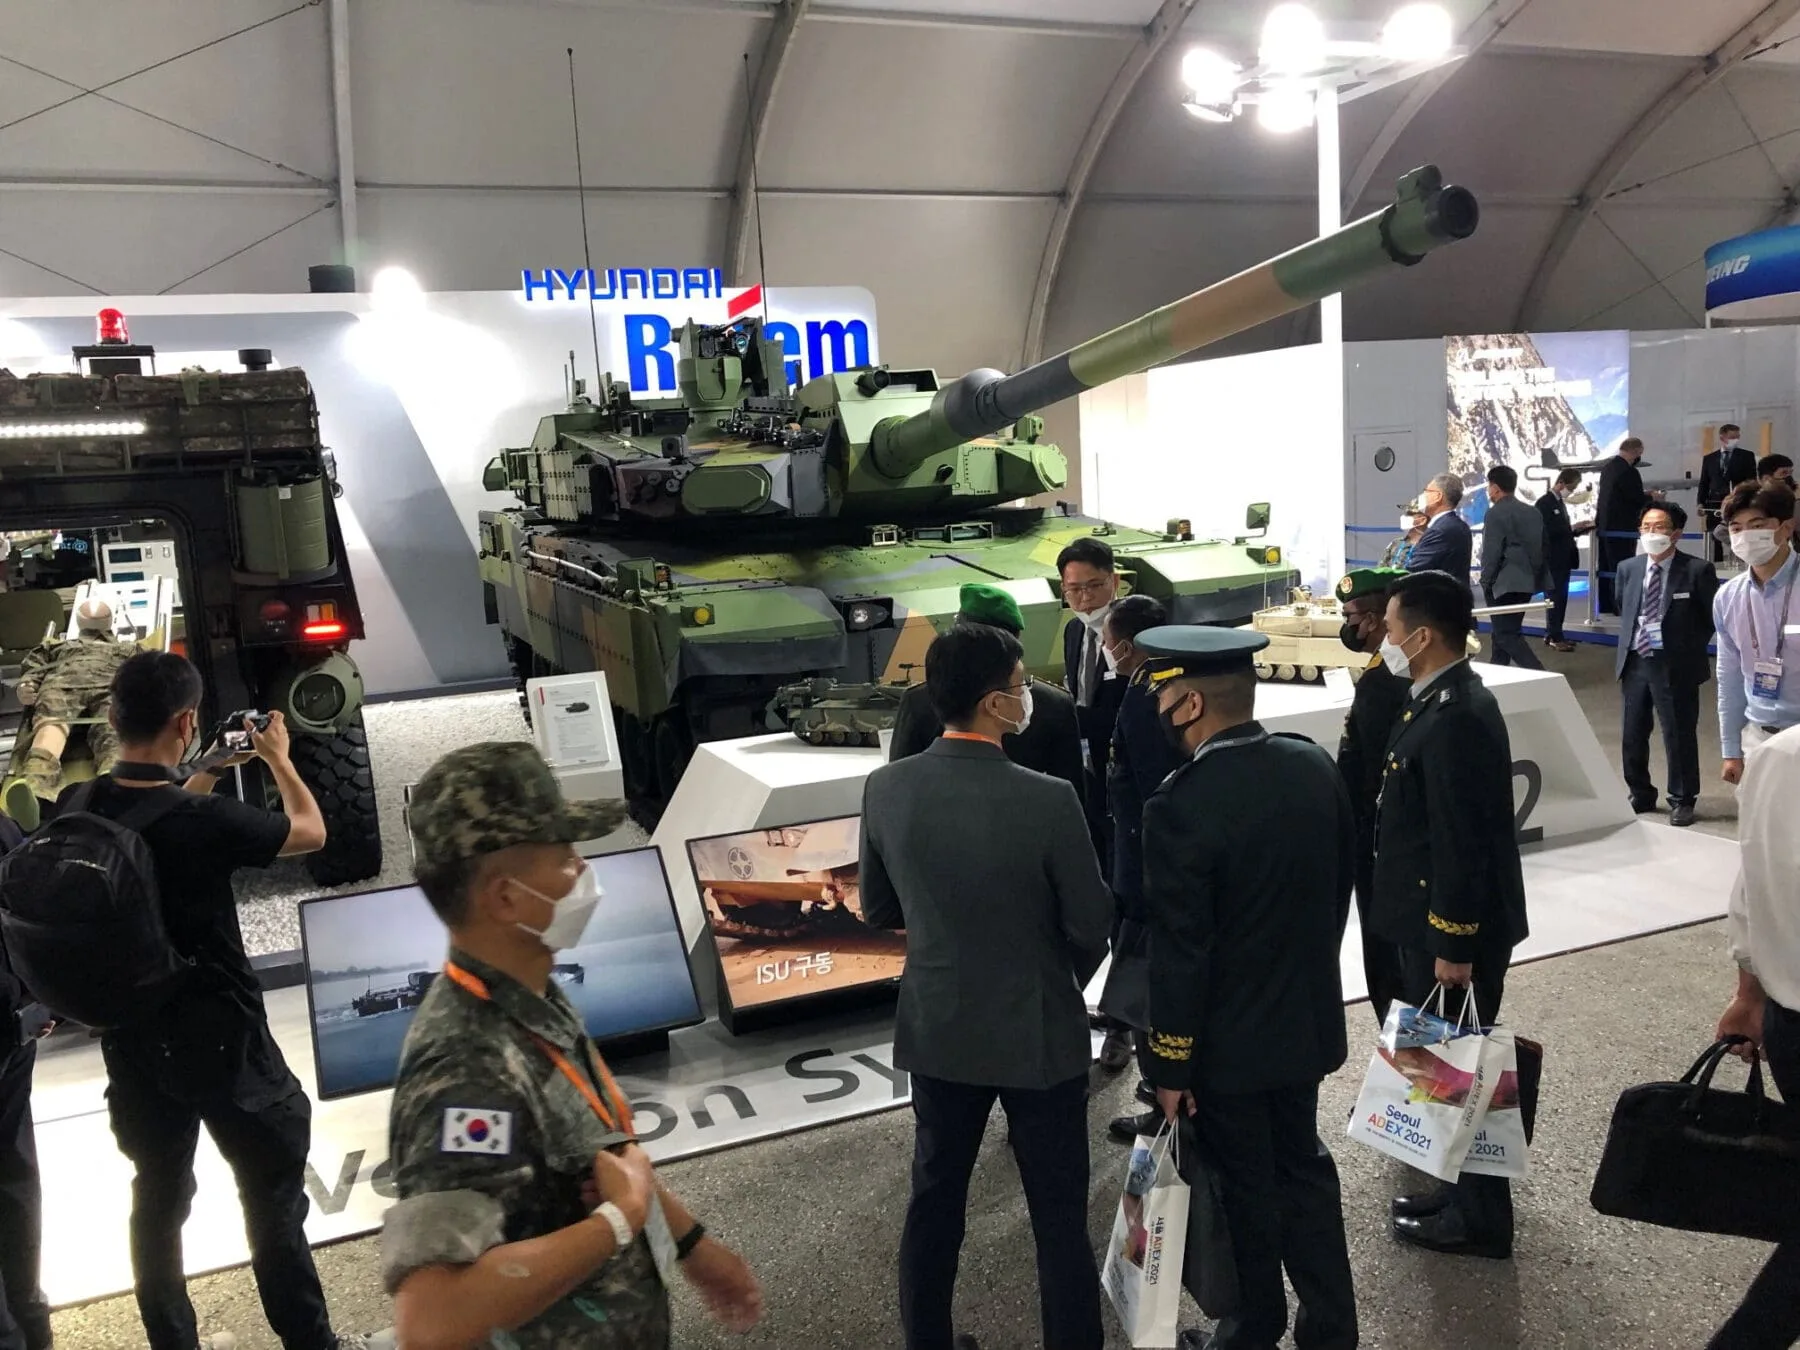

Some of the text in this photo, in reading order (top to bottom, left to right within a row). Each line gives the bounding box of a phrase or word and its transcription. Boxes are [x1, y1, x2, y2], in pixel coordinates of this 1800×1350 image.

[523, 268, 722, 301] HYUNDAI
[624, 313, 870, 393] Rem
[756, 952, 834, 985] ISU 구동
[1367, 1113, 1404, 1137] ADEX
[1404, 1129, 1432, 1150] 2021
[1385, 1104, 1421, 1129] Seoul
[1475, 1143, 1505, 1157] 2021
[1149, 1263, 1160, 1286] 2021
